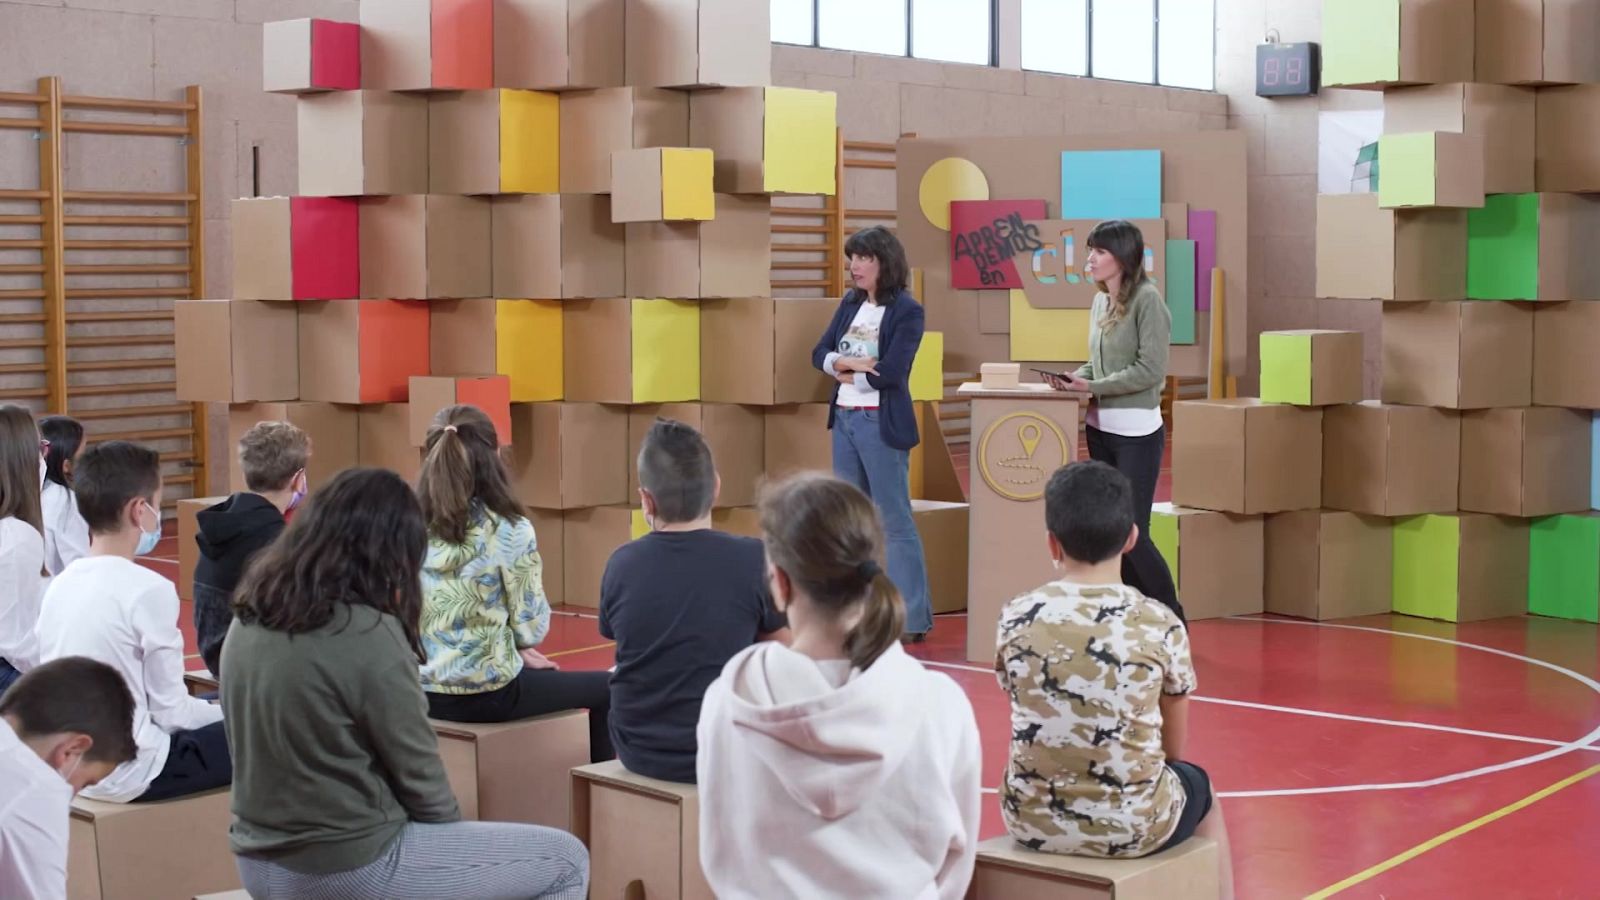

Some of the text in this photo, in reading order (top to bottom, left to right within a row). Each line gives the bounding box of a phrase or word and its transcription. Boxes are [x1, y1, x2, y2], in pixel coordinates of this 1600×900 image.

[954, 210, 1024, 261] APREN
[973, 223, 1042, 269] DEMOS
[979, 269, 1006, 285] en
